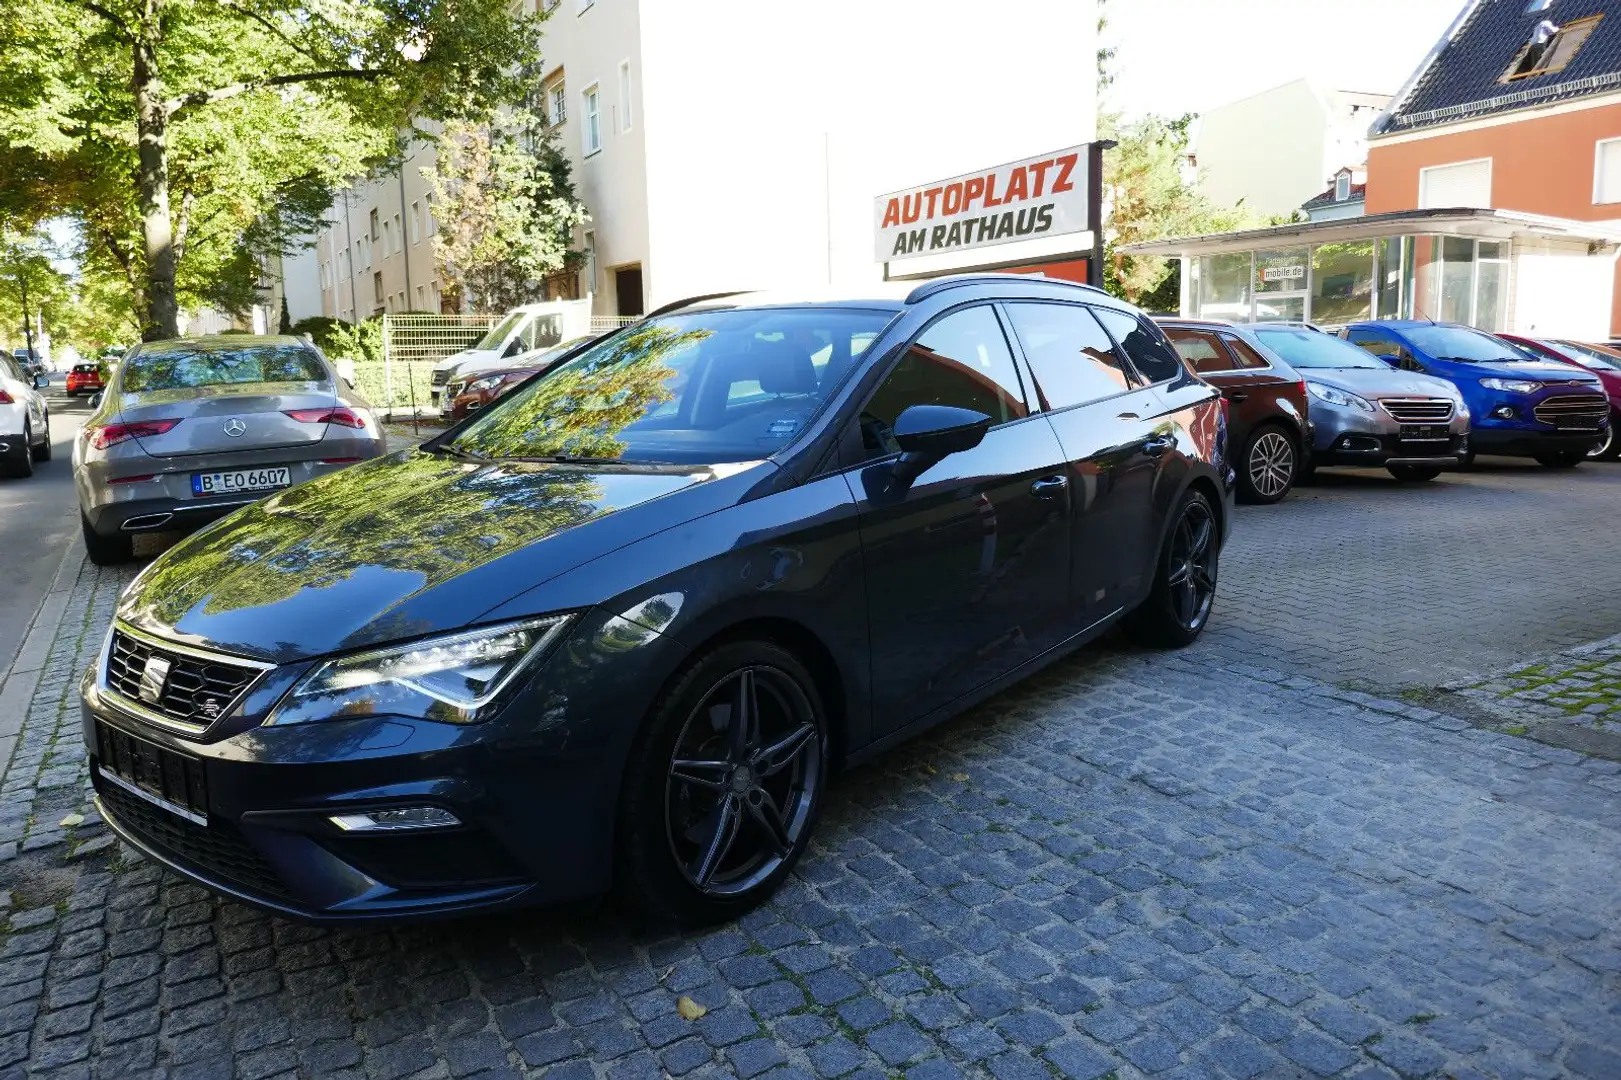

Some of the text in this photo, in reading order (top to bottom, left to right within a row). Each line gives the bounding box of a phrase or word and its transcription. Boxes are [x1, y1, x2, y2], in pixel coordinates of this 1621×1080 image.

[881, 153, 1078, 229] AUTOPLATZ
[892, 203, 1055, 256] AM RATHAUS
[1265, 267, 1302, 278] mobile.de
